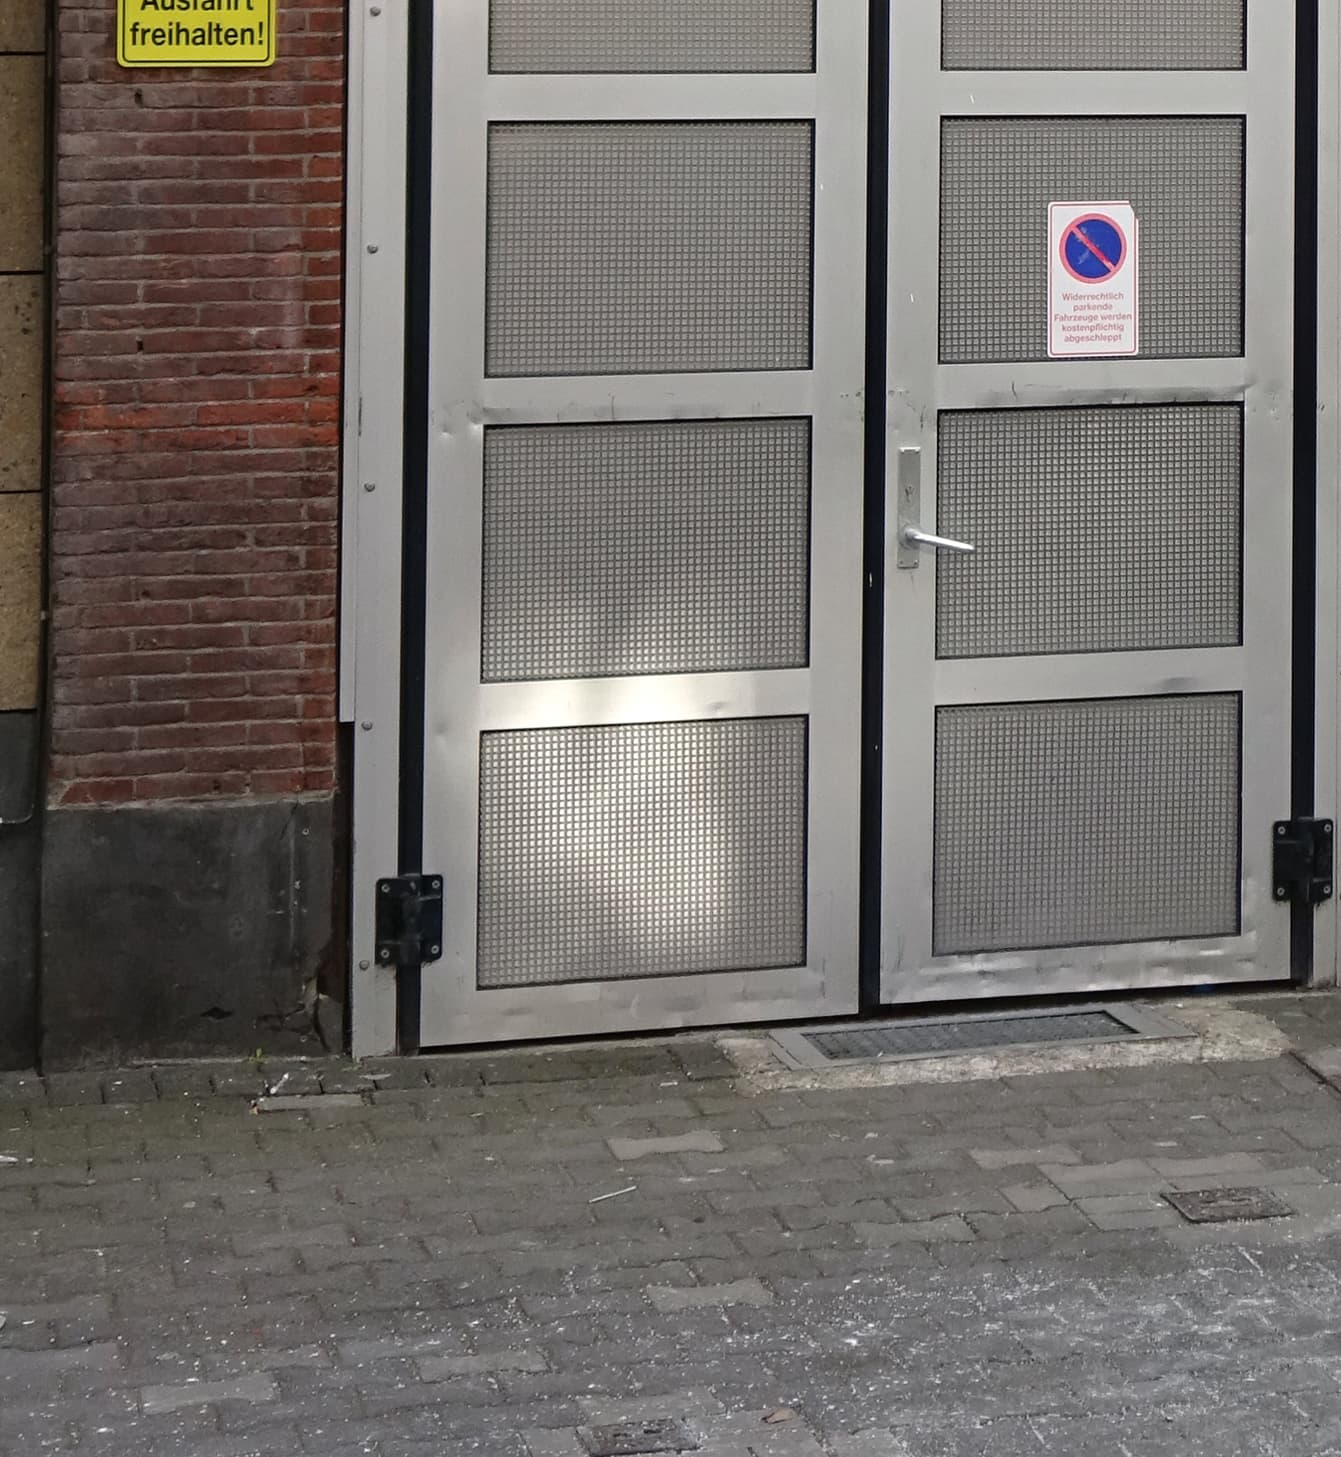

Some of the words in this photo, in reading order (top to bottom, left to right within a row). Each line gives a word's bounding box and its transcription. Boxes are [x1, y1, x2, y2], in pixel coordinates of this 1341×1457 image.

[130, 21, 264, 46] freihalten!
[1062, 291, 1124, 301] Widerrechtlich
[1073, 303, 1113, 312] parkende
[1054, 313, 1098, 323] Fahrzeuge
[1100, 312, 1132, 321] werden
[1061, 323, 1125, 333] kostenpflichtig
[1064, 333, 1122, 343] abgeschleppt
